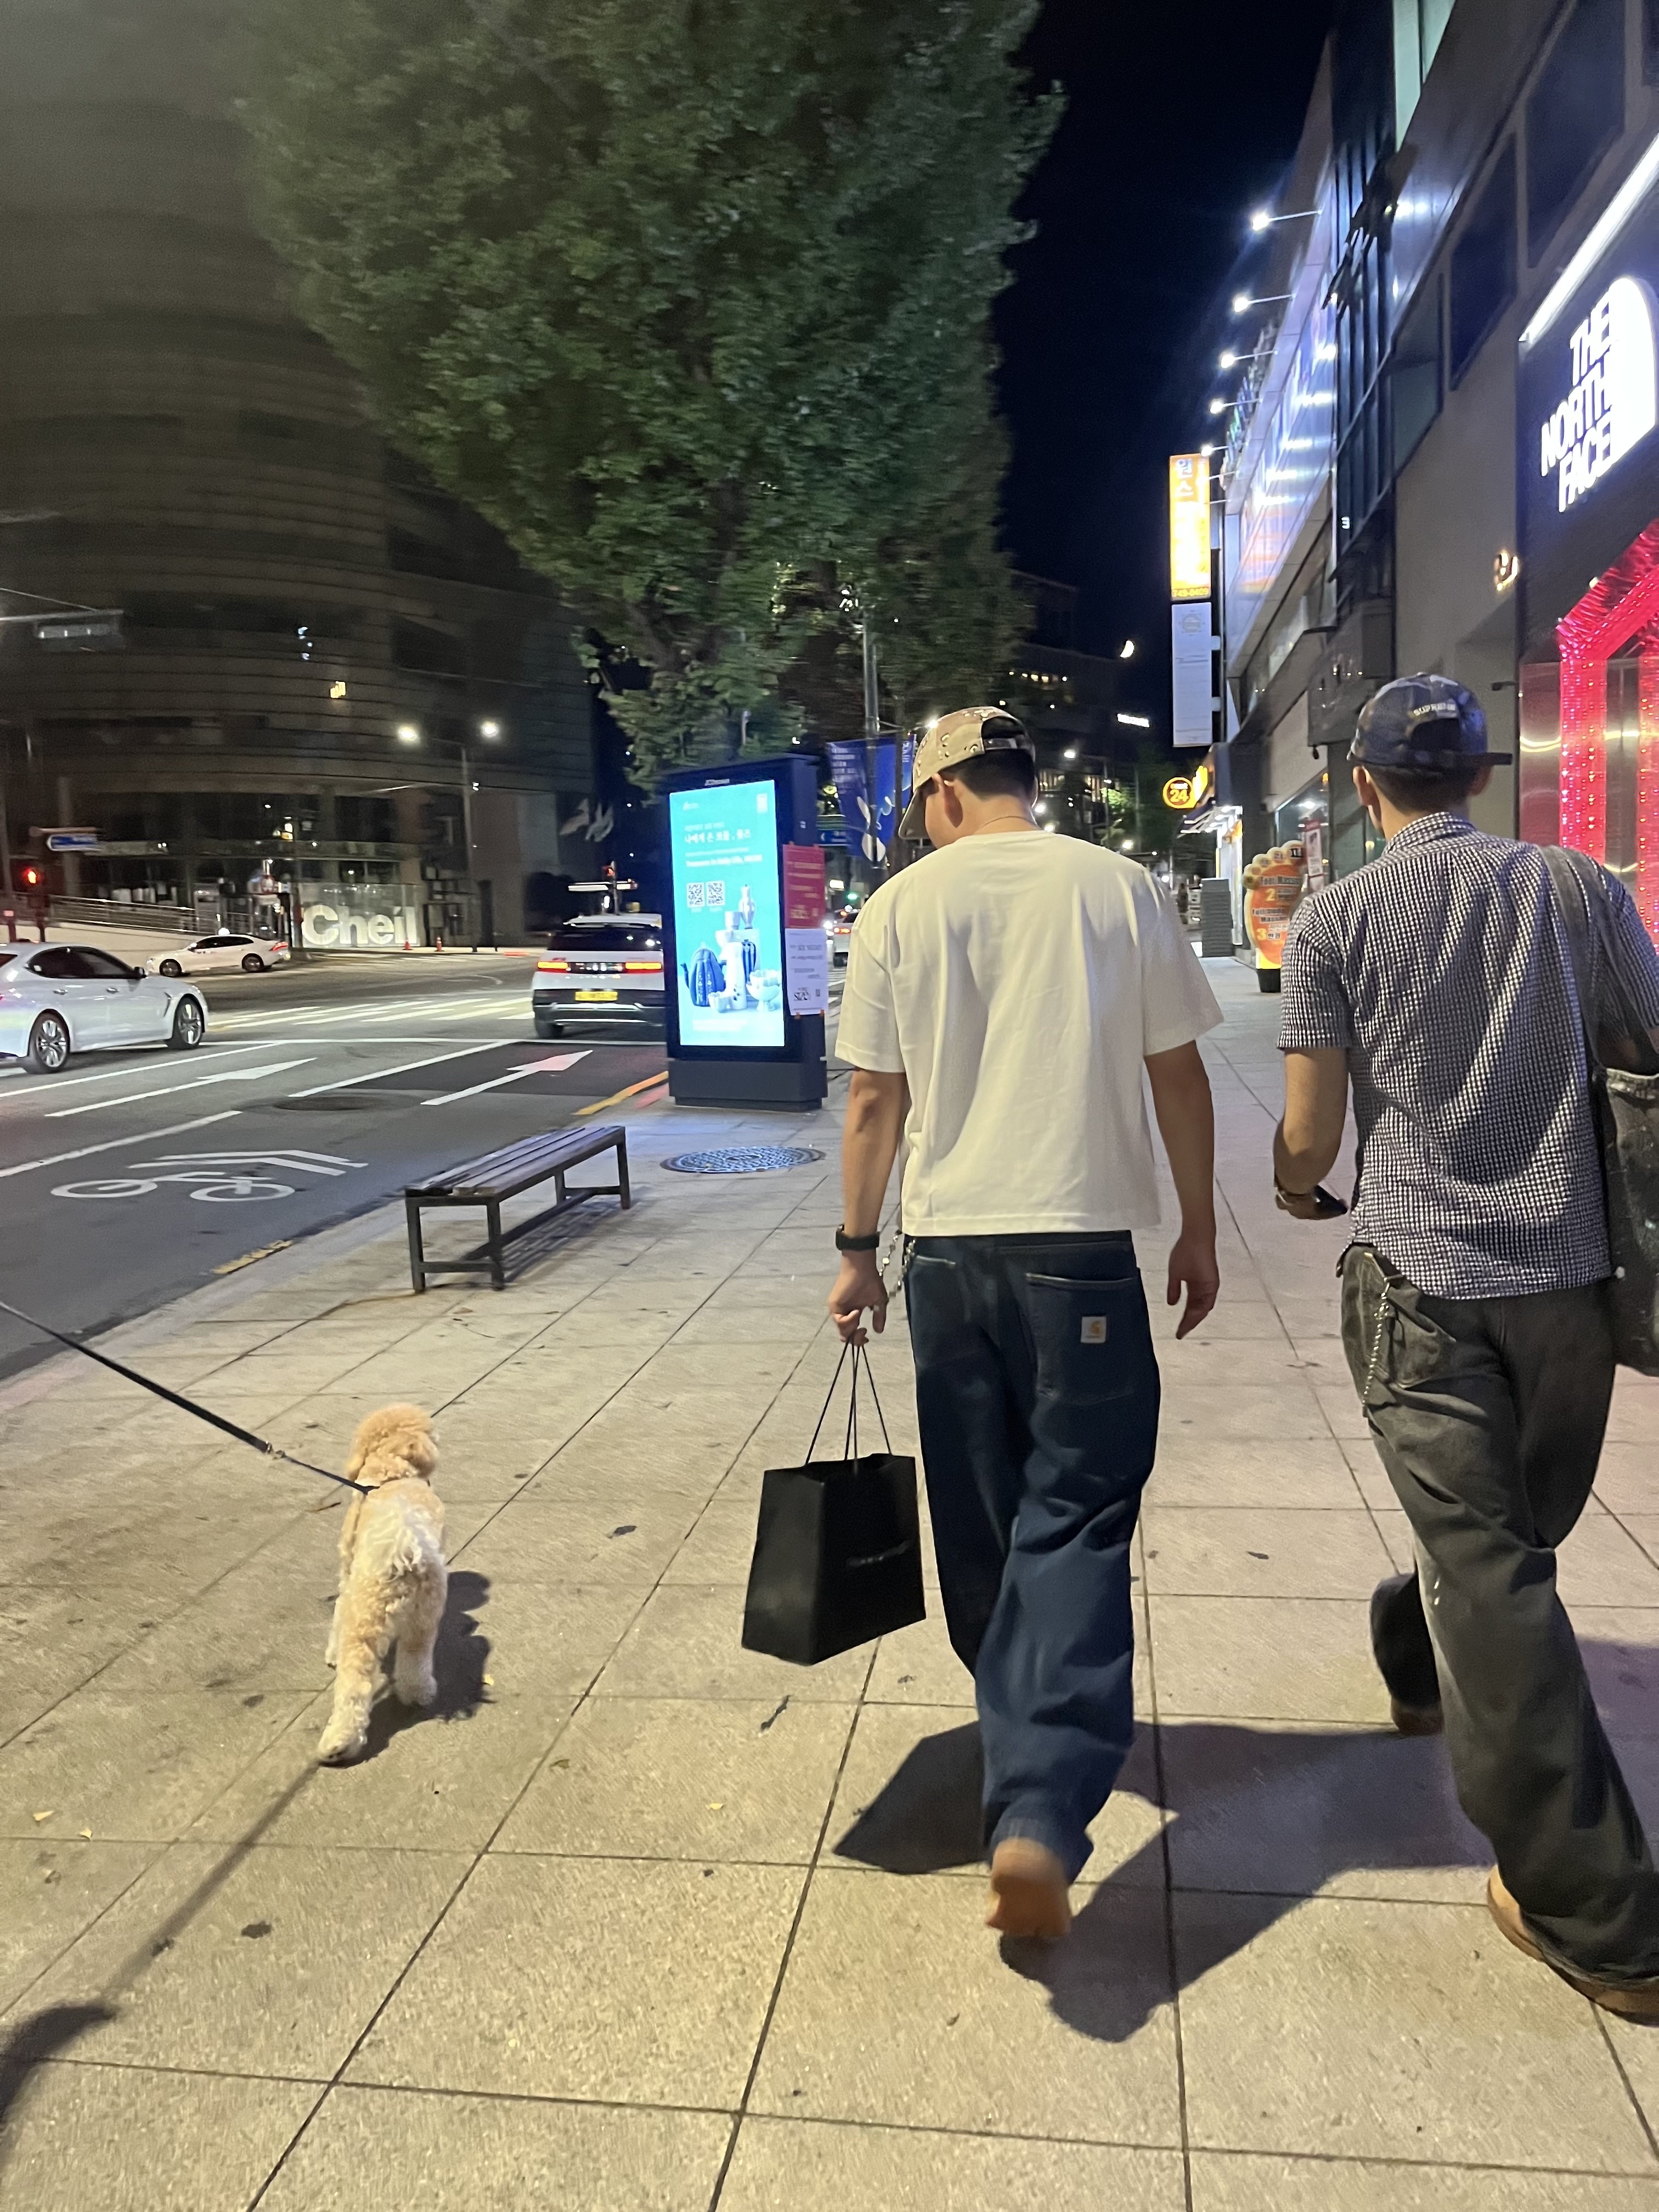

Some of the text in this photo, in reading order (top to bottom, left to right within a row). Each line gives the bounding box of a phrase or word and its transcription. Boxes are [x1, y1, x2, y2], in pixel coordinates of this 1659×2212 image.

[1570, 290, 1610, 386] THE
[1541, 350, 1613, 477] NORTH
[1559, 410, 1612, 513] FACE
[1170, 789, 1189, 803] 24
[1266, 888, 1276, 901] 2
[301, 904, 417, 945] Cheil
[1256, 928, 1267, 940] 3
